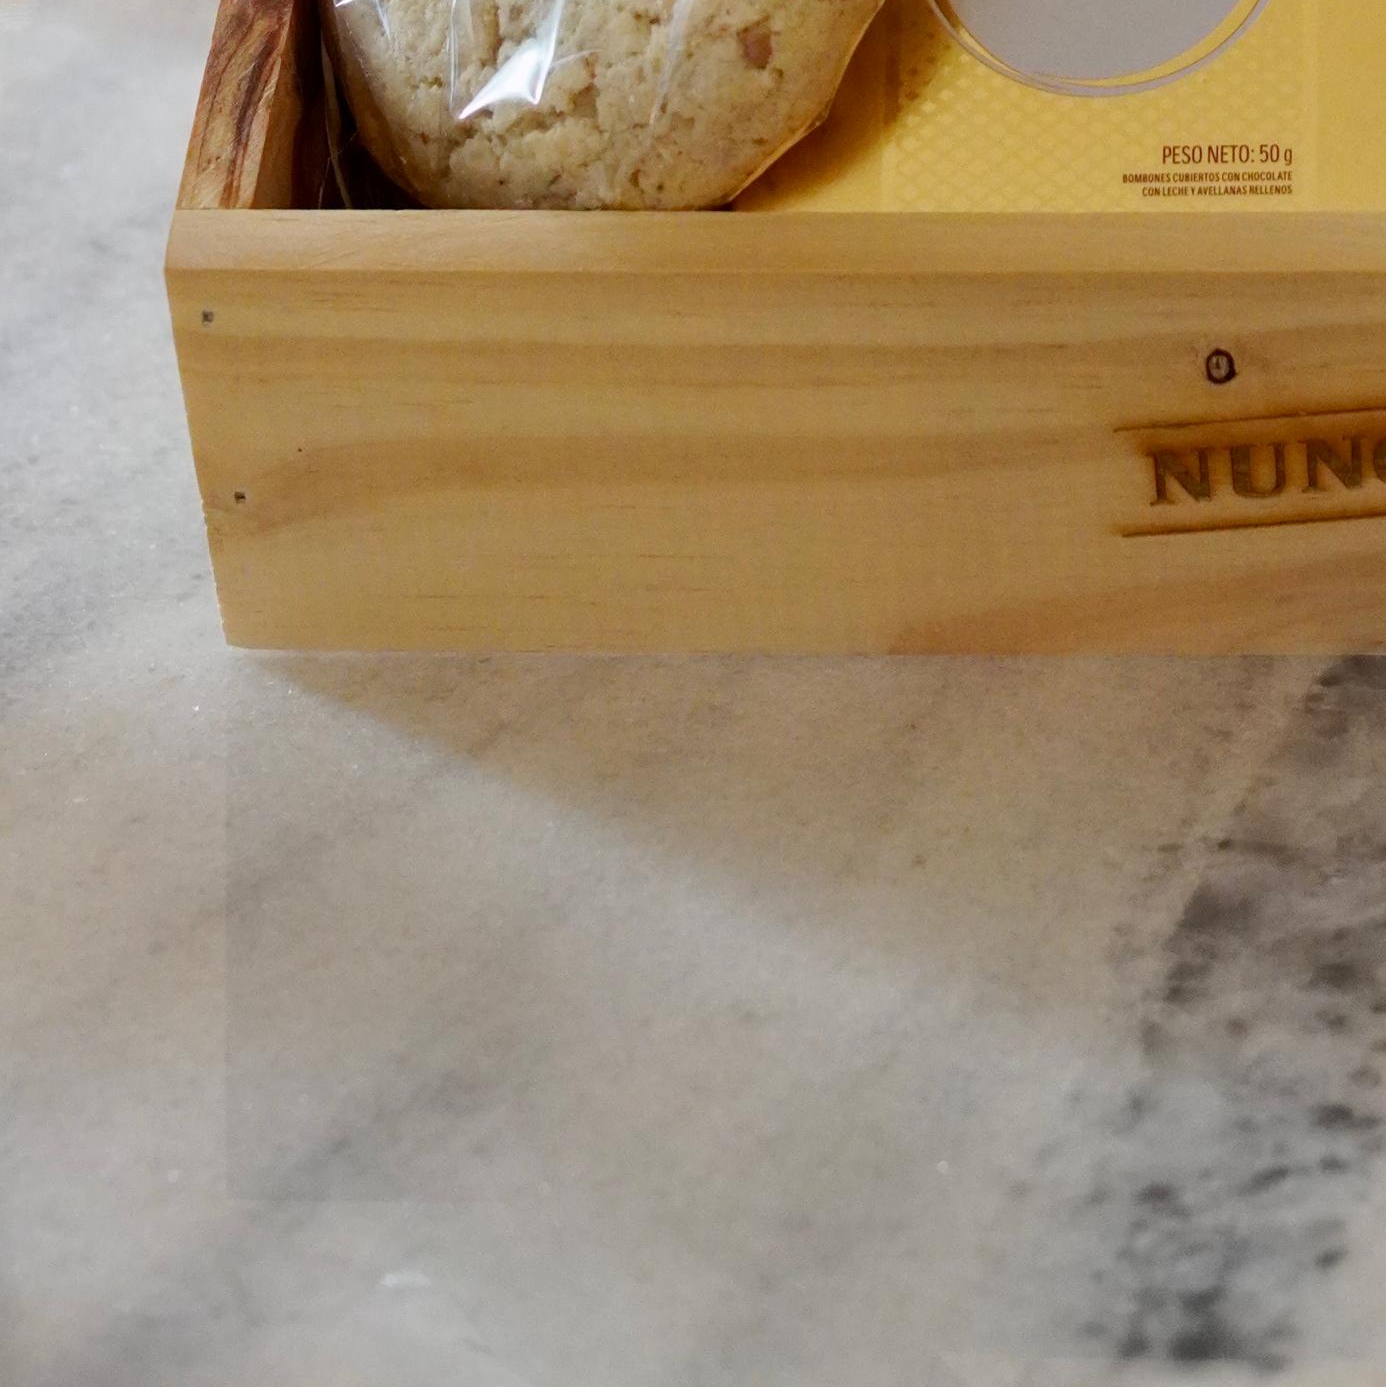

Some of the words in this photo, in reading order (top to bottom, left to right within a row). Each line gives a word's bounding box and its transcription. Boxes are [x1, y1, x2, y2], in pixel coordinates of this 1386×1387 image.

[1162, 144, 1203, 164] PESO
[1207, 144, 1255, 164] NETO:
[1259, 143, 1280, 164] 50
[1284, 148, 1293, 166] g
[1122, 172, 1171, 184] BOMBONES
[1172, 172, 1220, 183] CUBIERTOS
[1221, 172, 1240, 182] CON
[1241, 171, 1293, 182] CHOCOLATE
[1142, 187, 1161, 197] CON
[1162, 186, 1189, 197] LECHE
[1190, 186, 1196, 196] Y
[1197, 185, 1248, 196] AVELLANAS
[1249, 184, 1293, 195] RELLENOS
